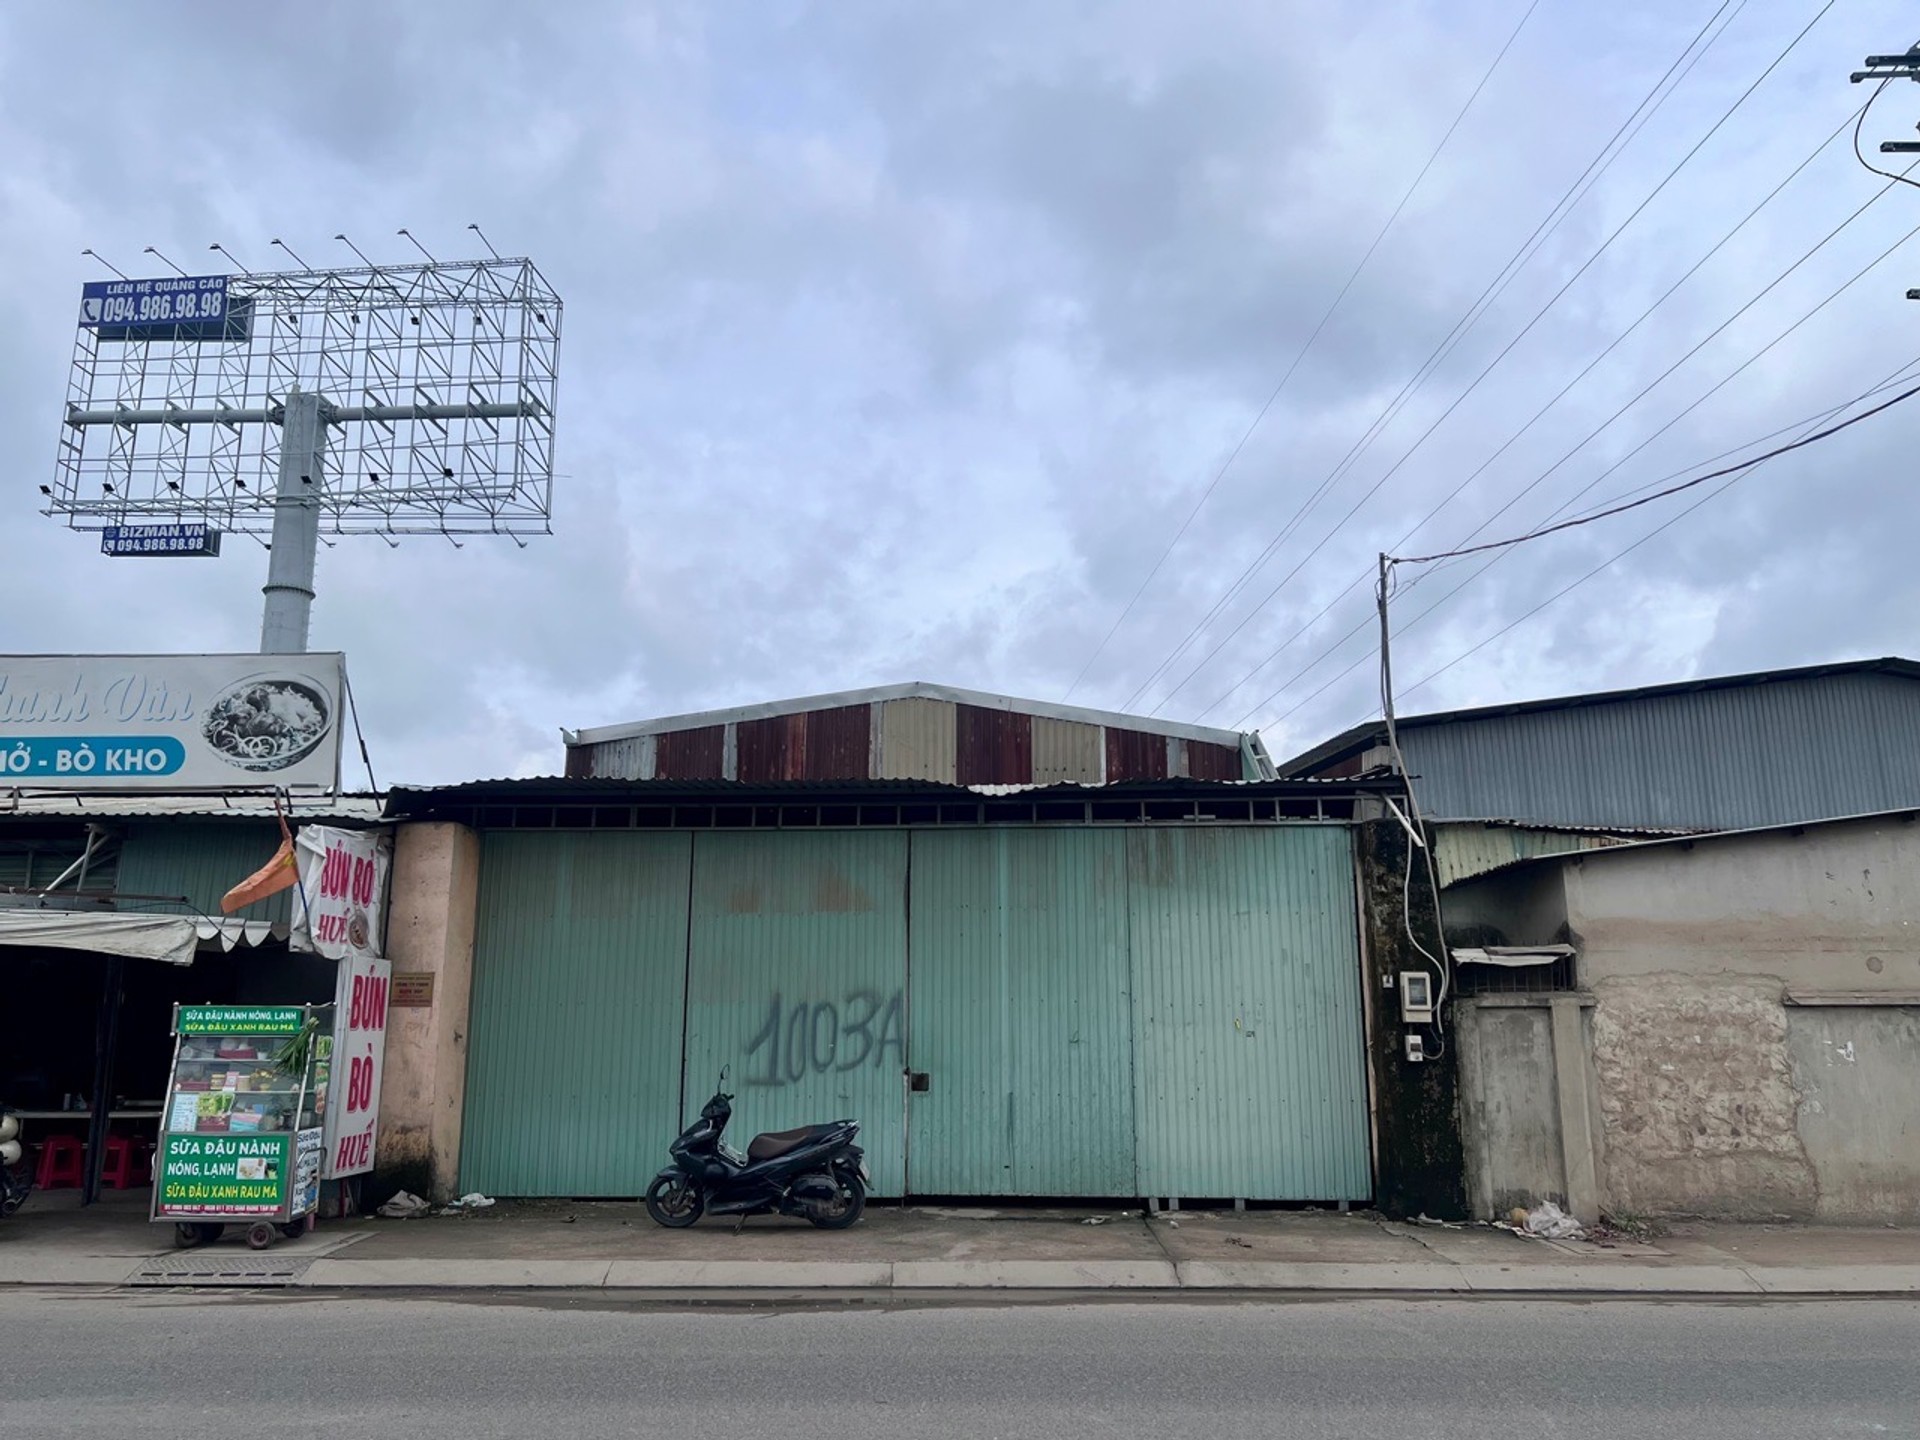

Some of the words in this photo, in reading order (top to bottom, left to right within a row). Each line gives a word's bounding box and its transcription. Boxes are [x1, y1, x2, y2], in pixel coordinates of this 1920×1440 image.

[107, 282, 133, 294] LIÊN
[136, 282, 152, 295] HỆ
[155, 278, 195, 291] QUẢNG
[199, 278, 223, 290] CÁO
[103, 292, 222, 322] 094.986.98.98
[117, 538, 204, 551] 094.986.98.98
[118, 525, 205, 538] BIZMAN.VN
[55, 742, 96, 772] BÒ
[105, 748, 167, 772] KHO
[321, 839, 352, 899] BÚN
[353, 849, 375, 908] BÒ
[317, 907, 350, 943] HUẾ
[349, 965, 388, 1031] BÚN
[186, 1009, 203, 1020] SỮA
[205, 1010, 223, 1022] ĐẬU
[224, 1010, 247, 1020] NÀNH
[274, 1012, 297, 1022] LẠNH
[743, 987, 904, 1087] 1003A
[347, 1043, 374, 1113] BÒ
[170, 1139, 201, 1155] SỮA
[204, 1140, 236, 1157] ĐẬU
[239, 1139, 280, 1155] NÀNH
[336, 1118, 375, 1171] HUẾ
[167, 1158, 201, 1176] NÓNG,
[204, 1162, 235, 1178] LẠNH
[166, 1182, 186, 1198] SỮA
[189, 1184, 210, 1201] ĐẬU
[210, 1185, 238, 1198] XANH
[239, 1184, 260, 1198] RAU
[261, 1182, 278, 1198] MÁ
